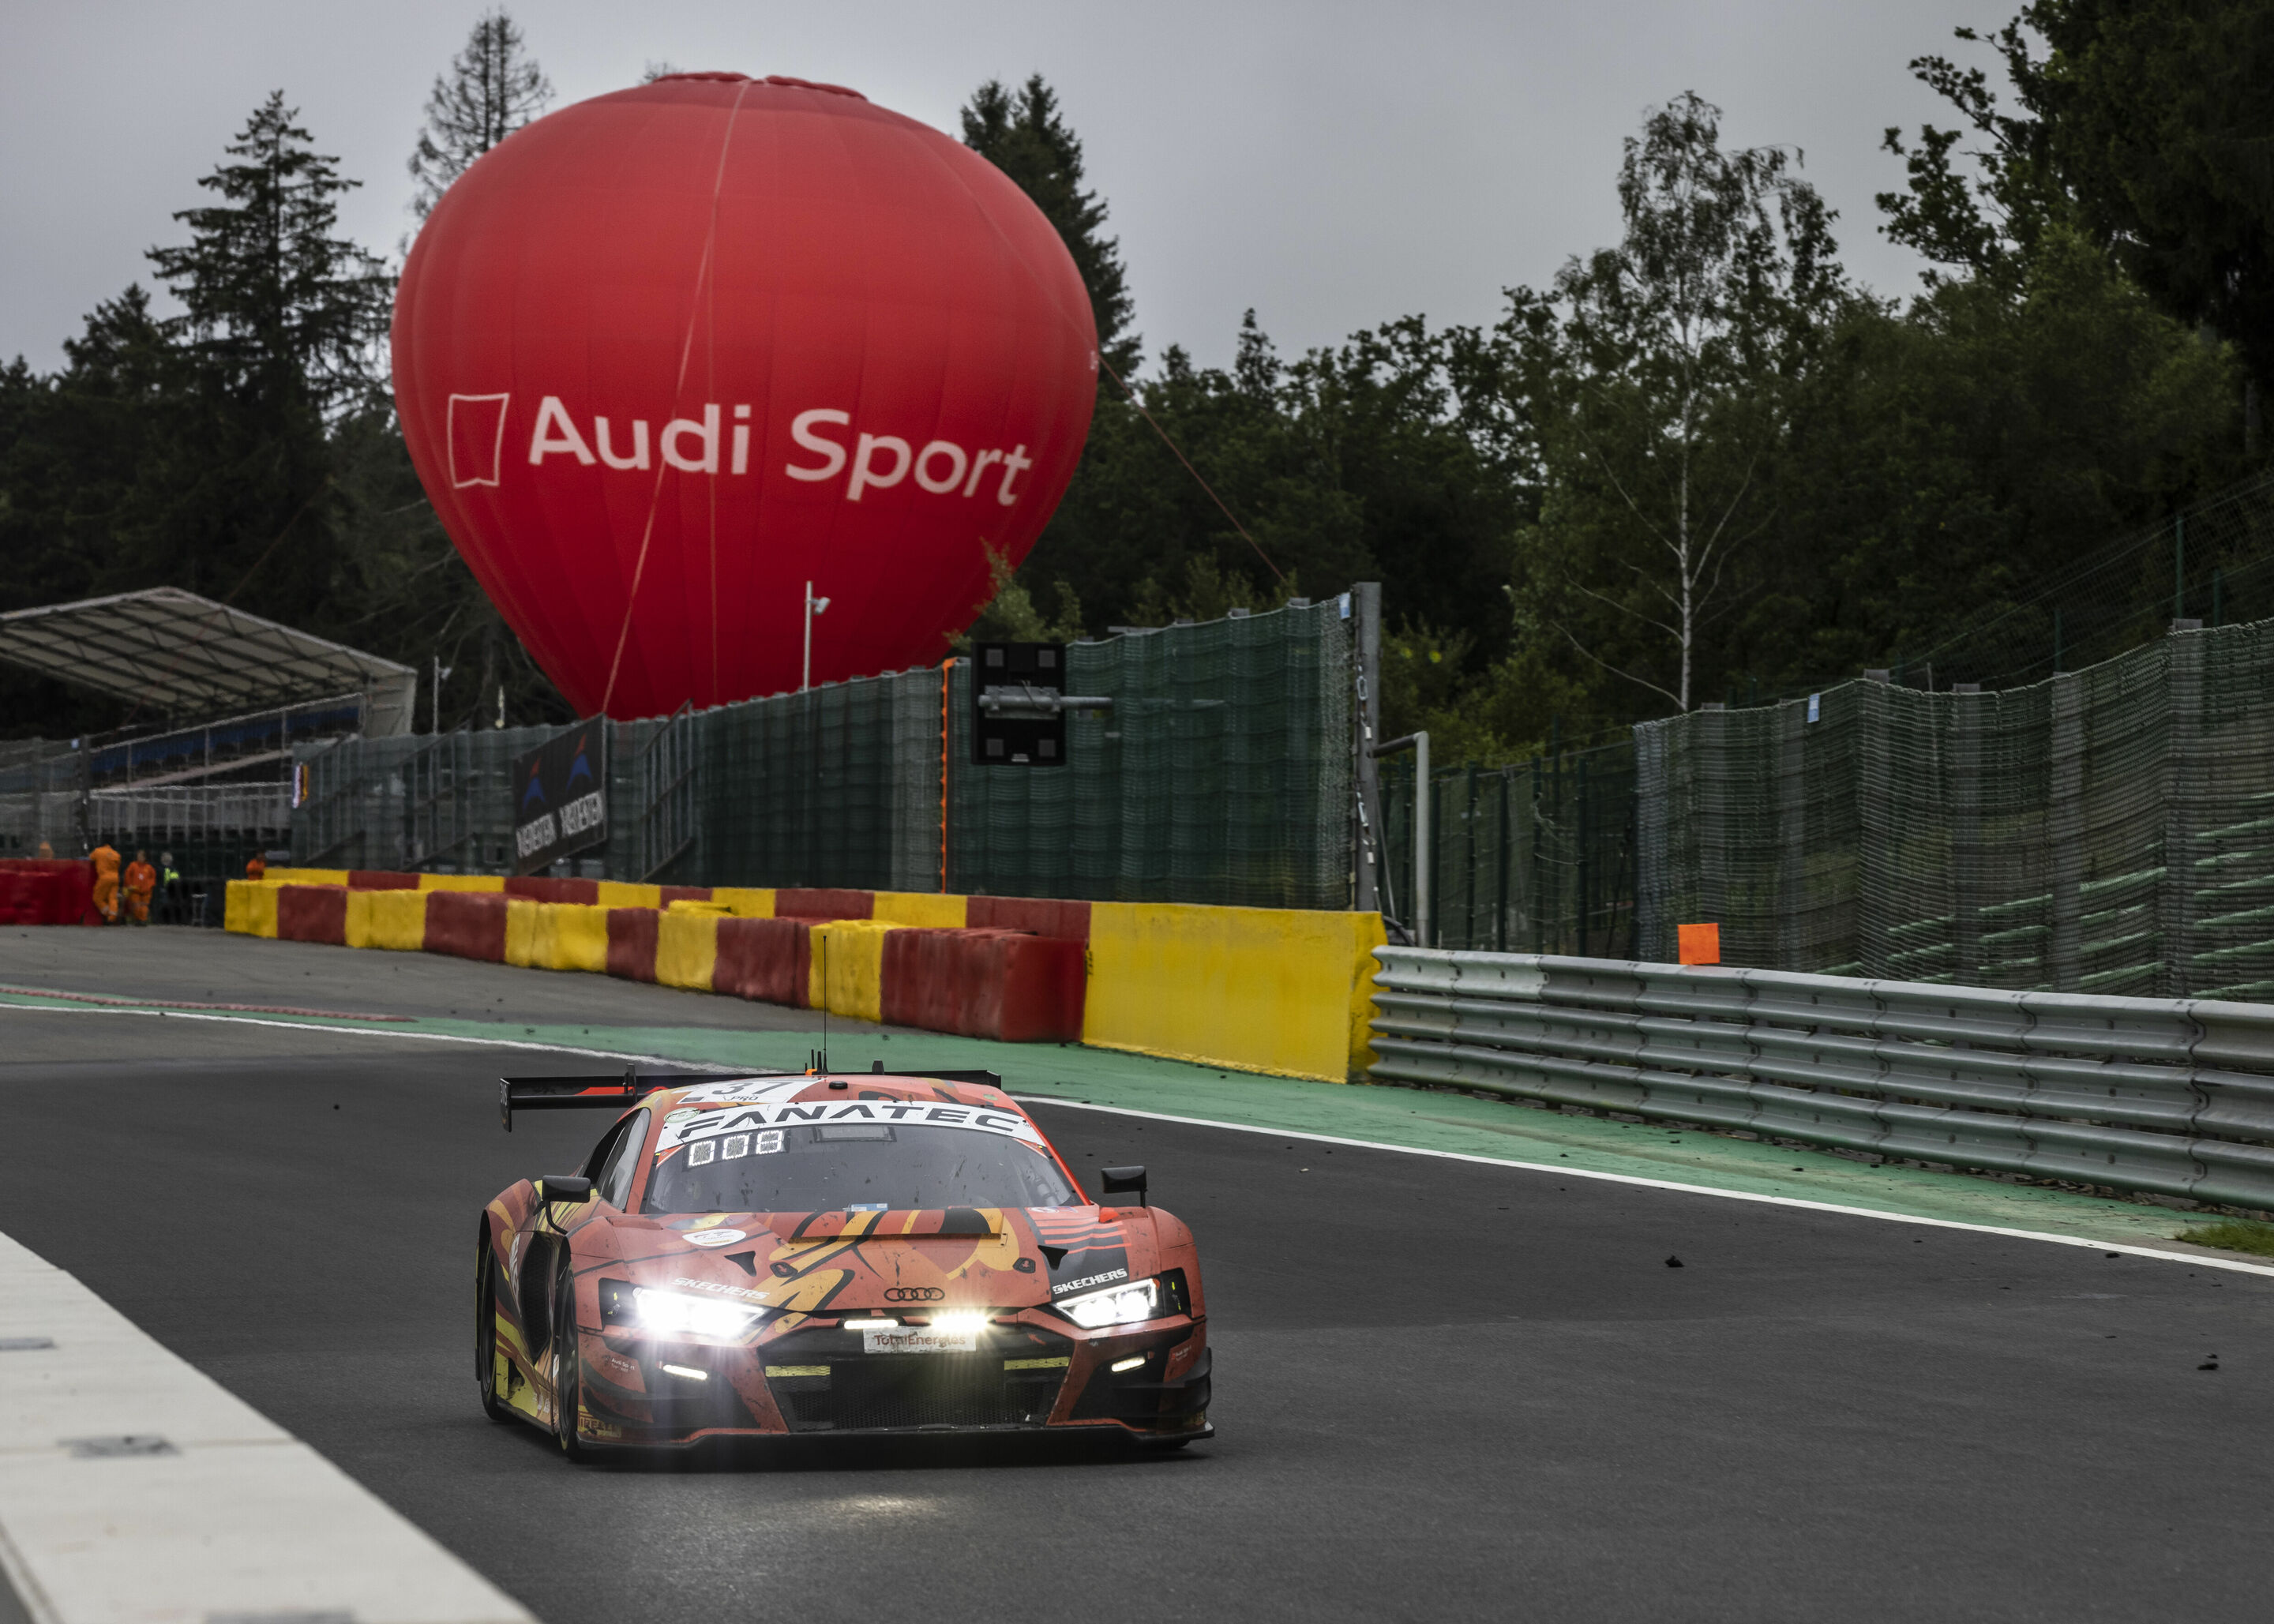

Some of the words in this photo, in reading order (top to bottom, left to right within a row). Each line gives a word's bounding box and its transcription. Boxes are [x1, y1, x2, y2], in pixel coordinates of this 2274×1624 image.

[527, 396, 752, 474] Audi
[785, 408, 1033, 506] Sport
[712, 1082, 792, 1095] 37
[677, 1105, 1021, 1139] FANATEC
[671, 1277, 771, 1300] SKECHERS
[1052, 1268, 1128, 1295] SKECHERS
